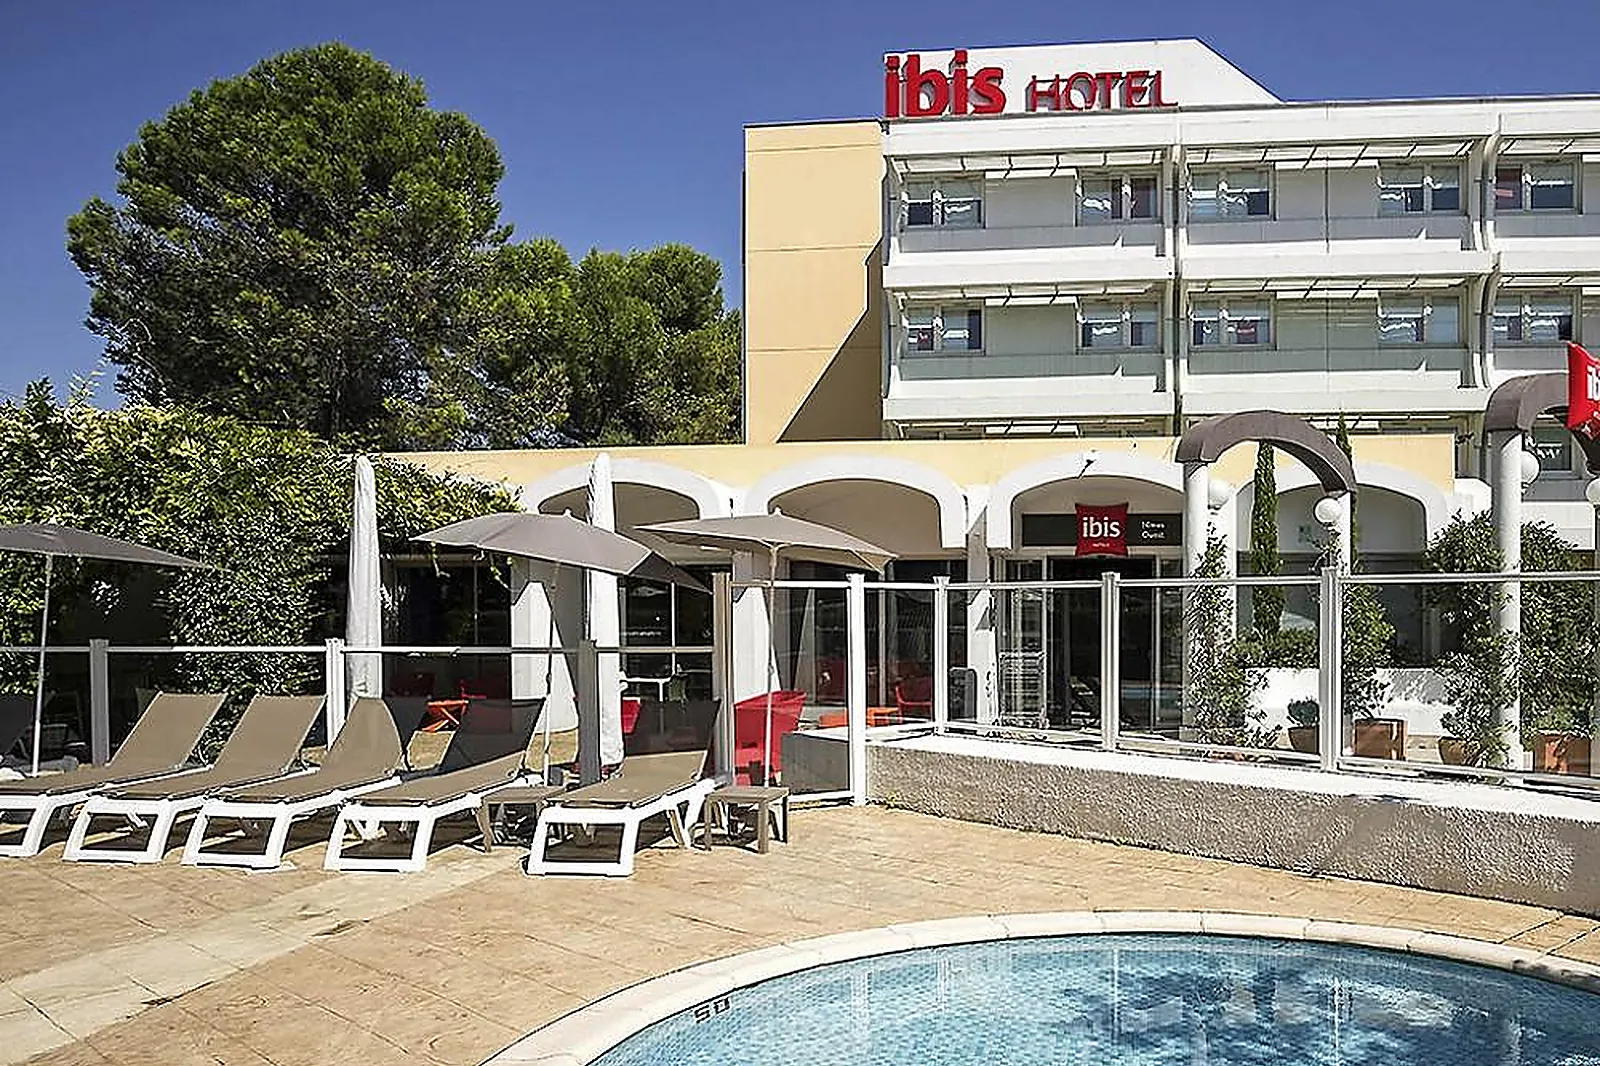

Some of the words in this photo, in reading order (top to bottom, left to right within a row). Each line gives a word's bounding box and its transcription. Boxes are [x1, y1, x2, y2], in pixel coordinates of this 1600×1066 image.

[885, 49, 1006, 118] ibis
[1029, 69, 1179, 112] HOTEL
[1082, 516, 1121, 538] ibis
